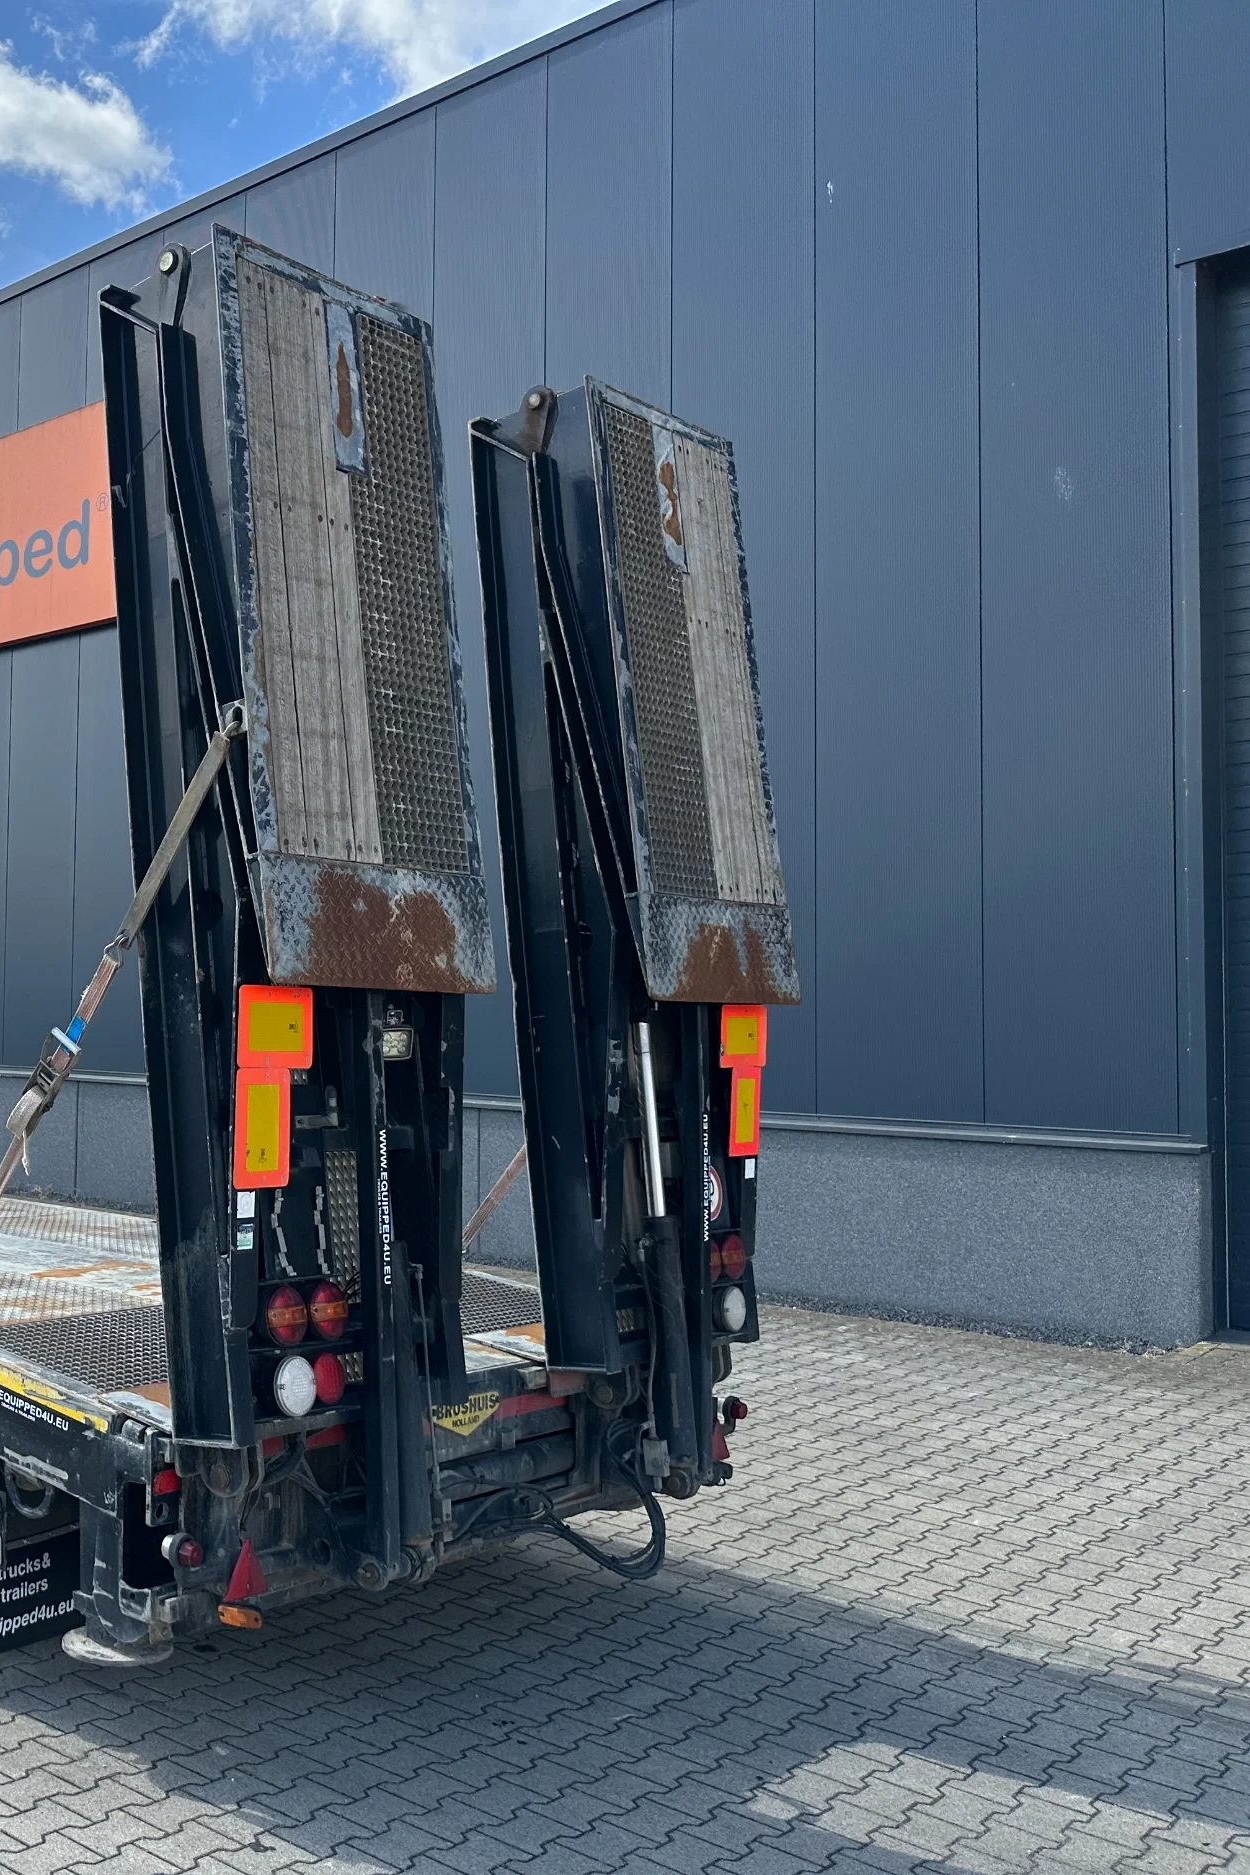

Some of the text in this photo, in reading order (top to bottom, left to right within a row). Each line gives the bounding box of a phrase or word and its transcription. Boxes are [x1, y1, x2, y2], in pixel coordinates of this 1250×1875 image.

[378, 1129, 392, 1285] WWW.EQUIPPED4U.EU
[436, 1393, 496, 1420] BROSHUIS
[452, 1414, 480, 1428] HOLLAND
[0, 1578, 49, 1603] trailers
